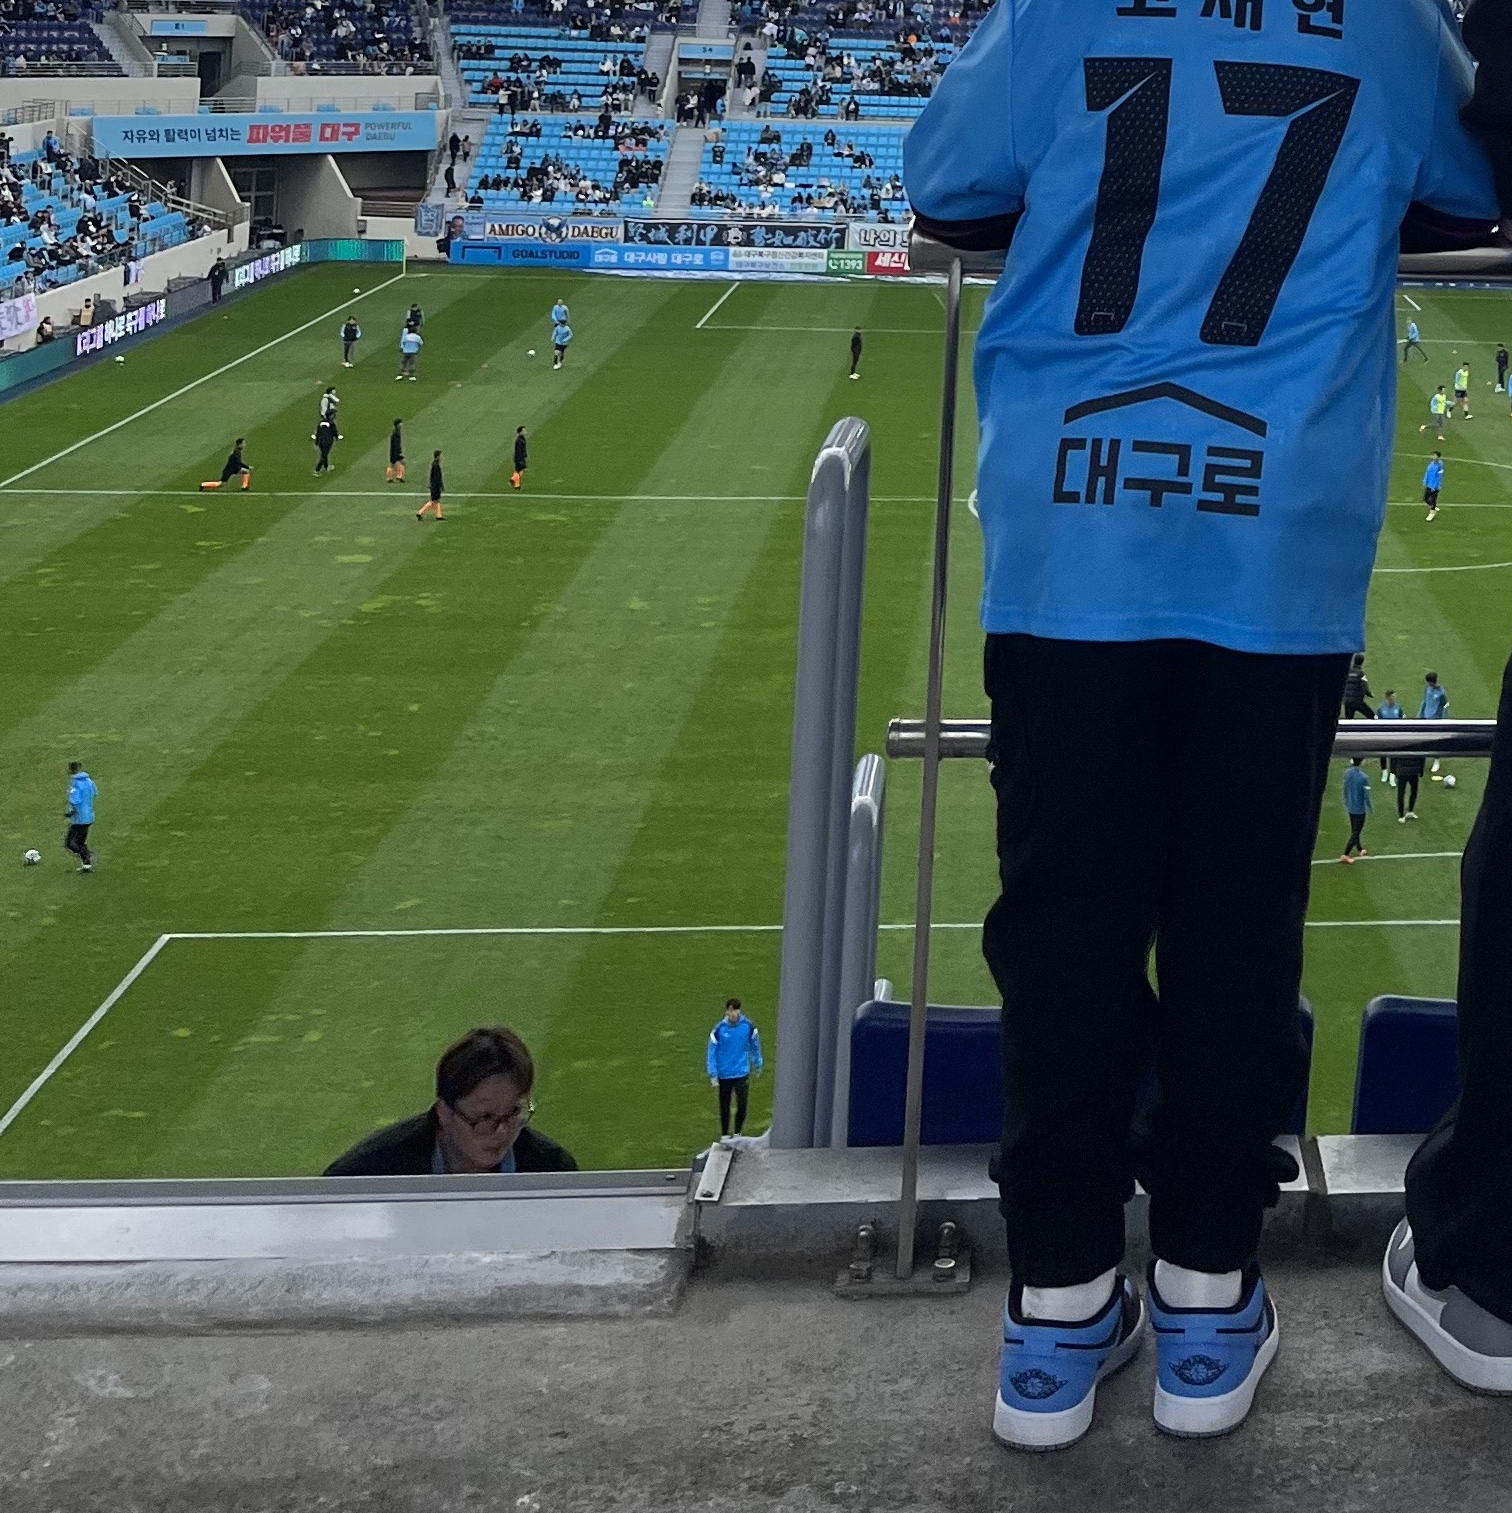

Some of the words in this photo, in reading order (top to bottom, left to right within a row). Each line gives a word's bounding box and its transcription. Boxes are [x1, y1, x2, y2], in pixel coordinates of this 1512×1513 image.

[122, 128, 161, 143] 자유와
[164, 128, 201, 142] 활력이
[205, 127, 241, 142] 넘치는
[246, 123, 313, 144] 파워풀
[318, 122, 361, 143] 대구
[365, 122, 413, 131] POWERFUL
[1073, 56, 1361, 347] 17
[489, 223, 536, 237] AMIGO
[570, 225, 619, 239] DAEGU
[860, 228, 897, 247] 나의
[511, 248, 581, 261] GOALSTUDIO
[671, 252, 705, 265] 대구로
[840, 259, 863, 271] 1393
[1052, 436, 1265, 518] 대구로
